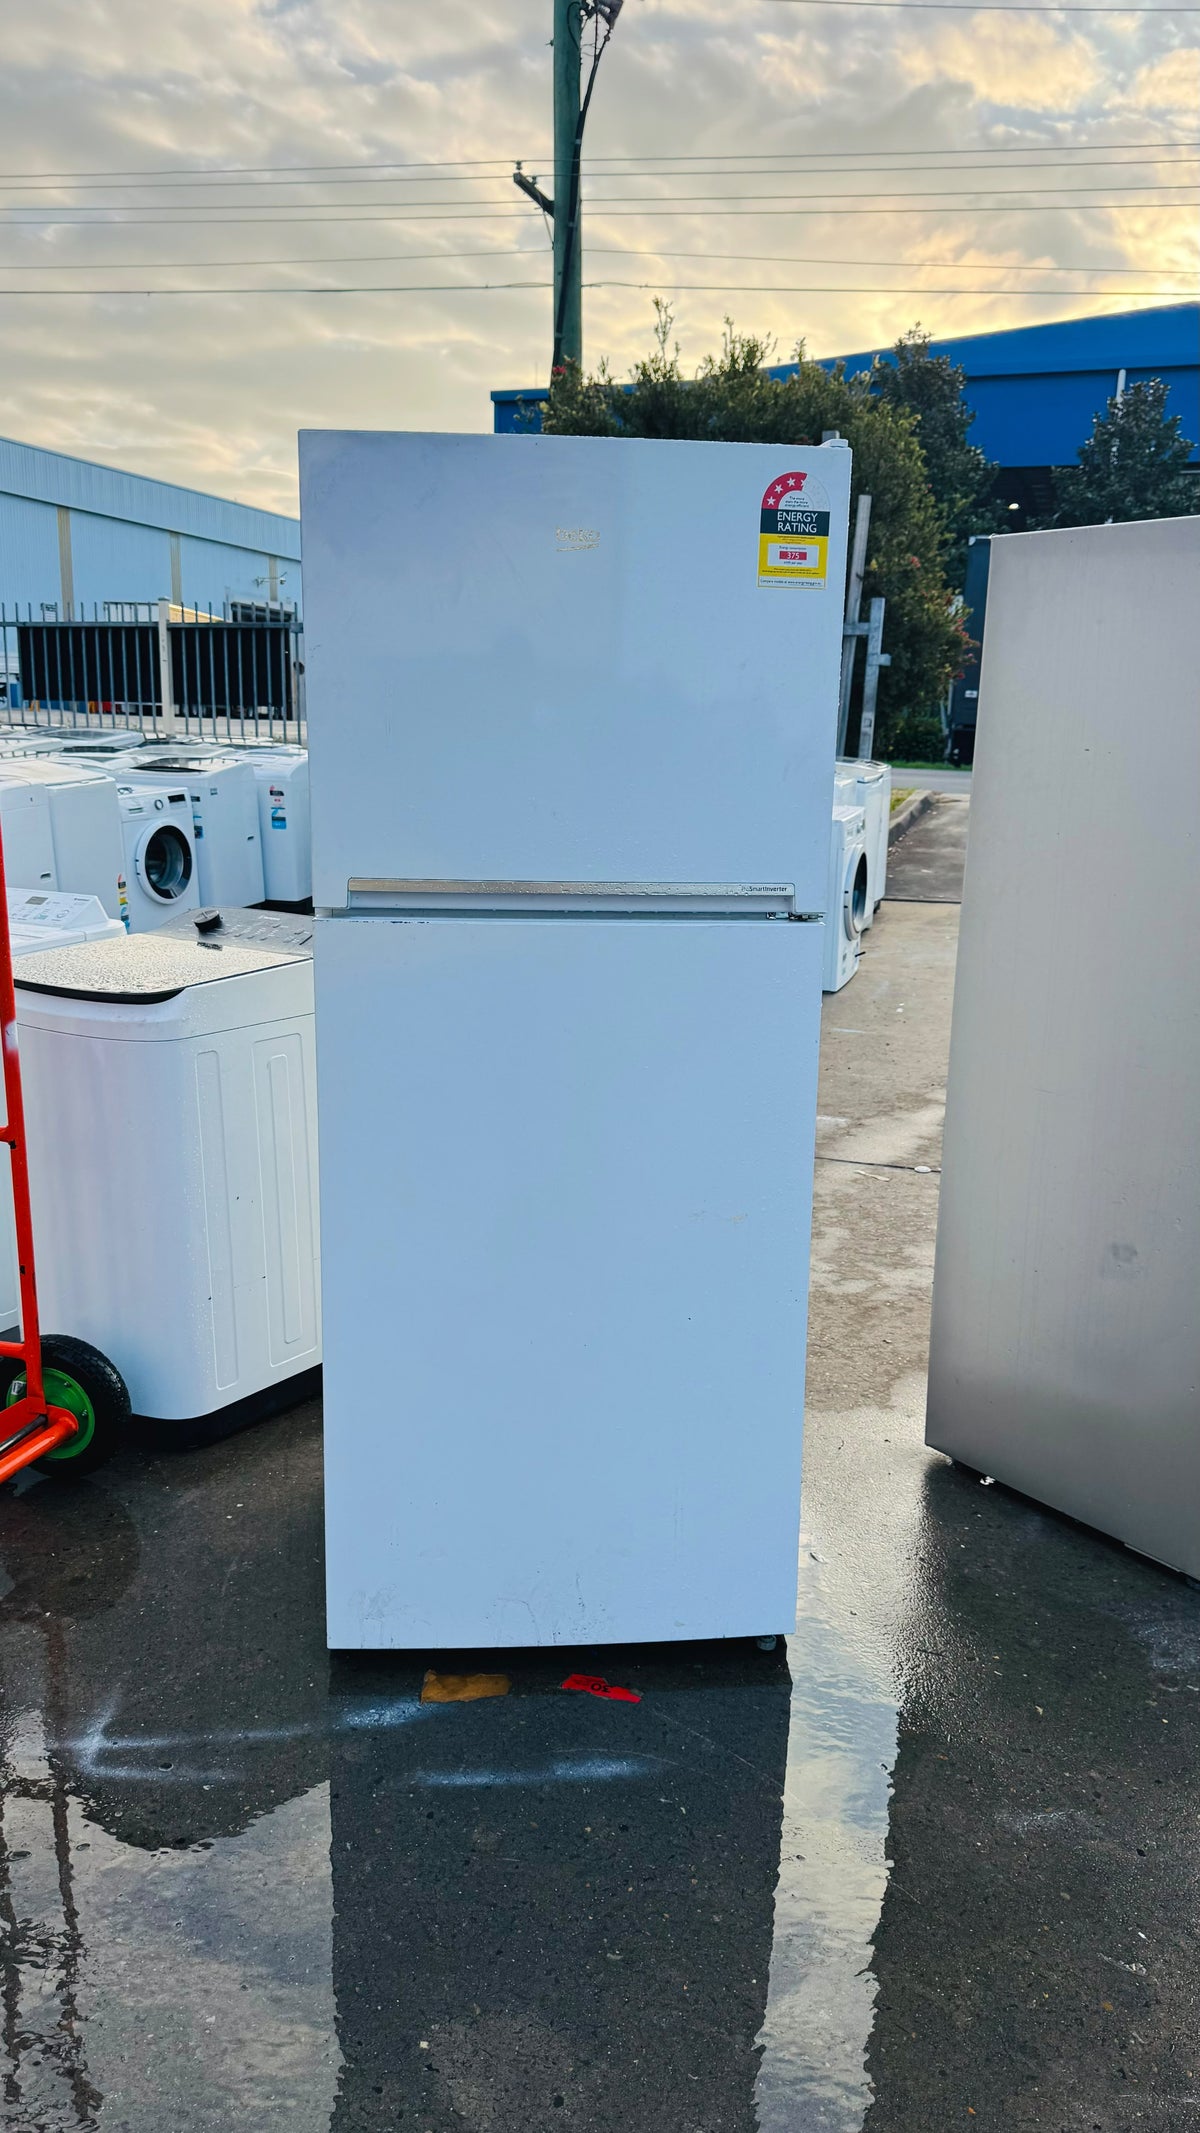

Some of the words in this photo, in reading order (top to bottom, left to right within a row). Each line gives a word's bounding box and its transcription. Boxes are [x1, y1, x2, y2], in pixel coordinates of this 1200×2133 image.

[777, 511, 818, 523] ENERGY
[777, 521, 817, 533] RATING
[787, 551, 800, 560] 375
